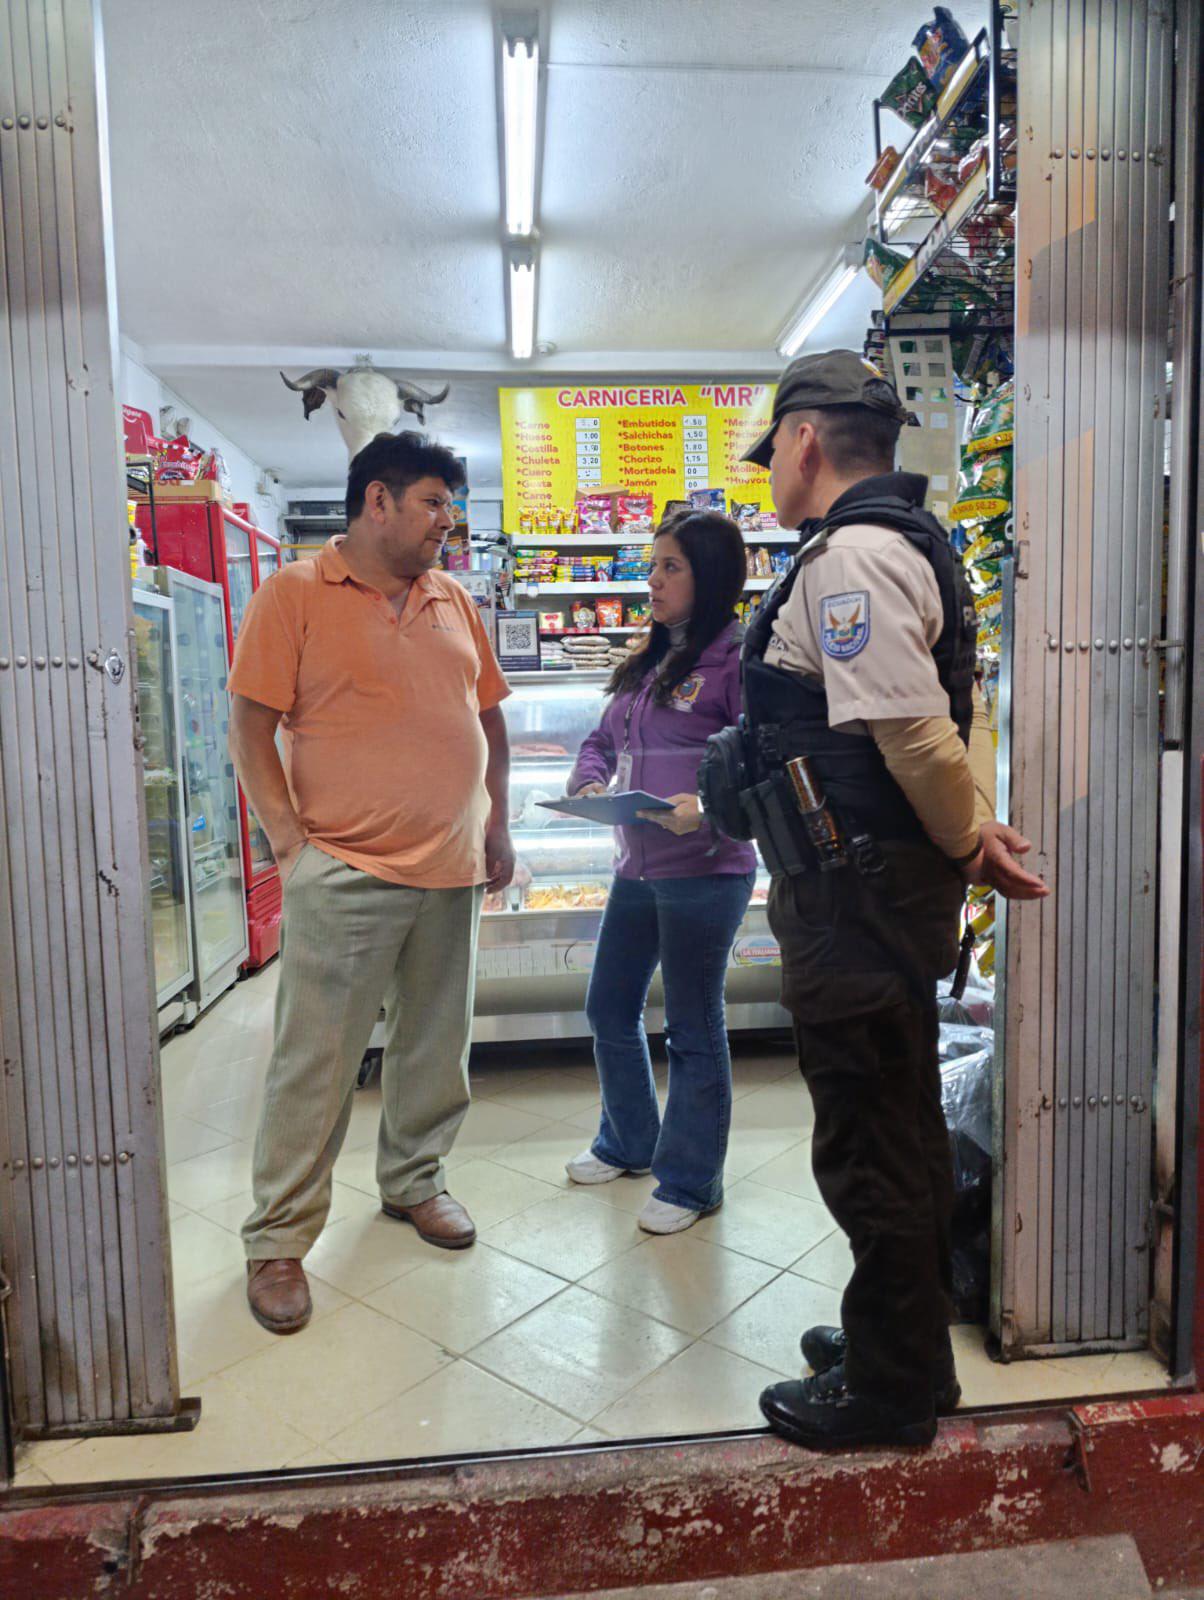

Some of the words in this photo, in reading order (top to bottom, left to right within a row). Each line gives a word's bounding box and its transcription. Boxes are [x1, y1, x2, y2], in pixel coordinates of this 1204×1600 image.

[558, 389, 687, 408] CARNICERIA
[622, 419, 677, 428] Embutidos
[623, 431, 673, 440] Salchichas
[520, 444, 559, 453] Costilla
[623, 443, 665, 452] Botones
[521, 456, 561, 465] Chuleta
[623, 455, 663, 464] Chorizo
[521, 468, 553, 477] Cuero
[623, 465, 677, 475] Mortadela
[624, 478, 657, 487] Jamón
